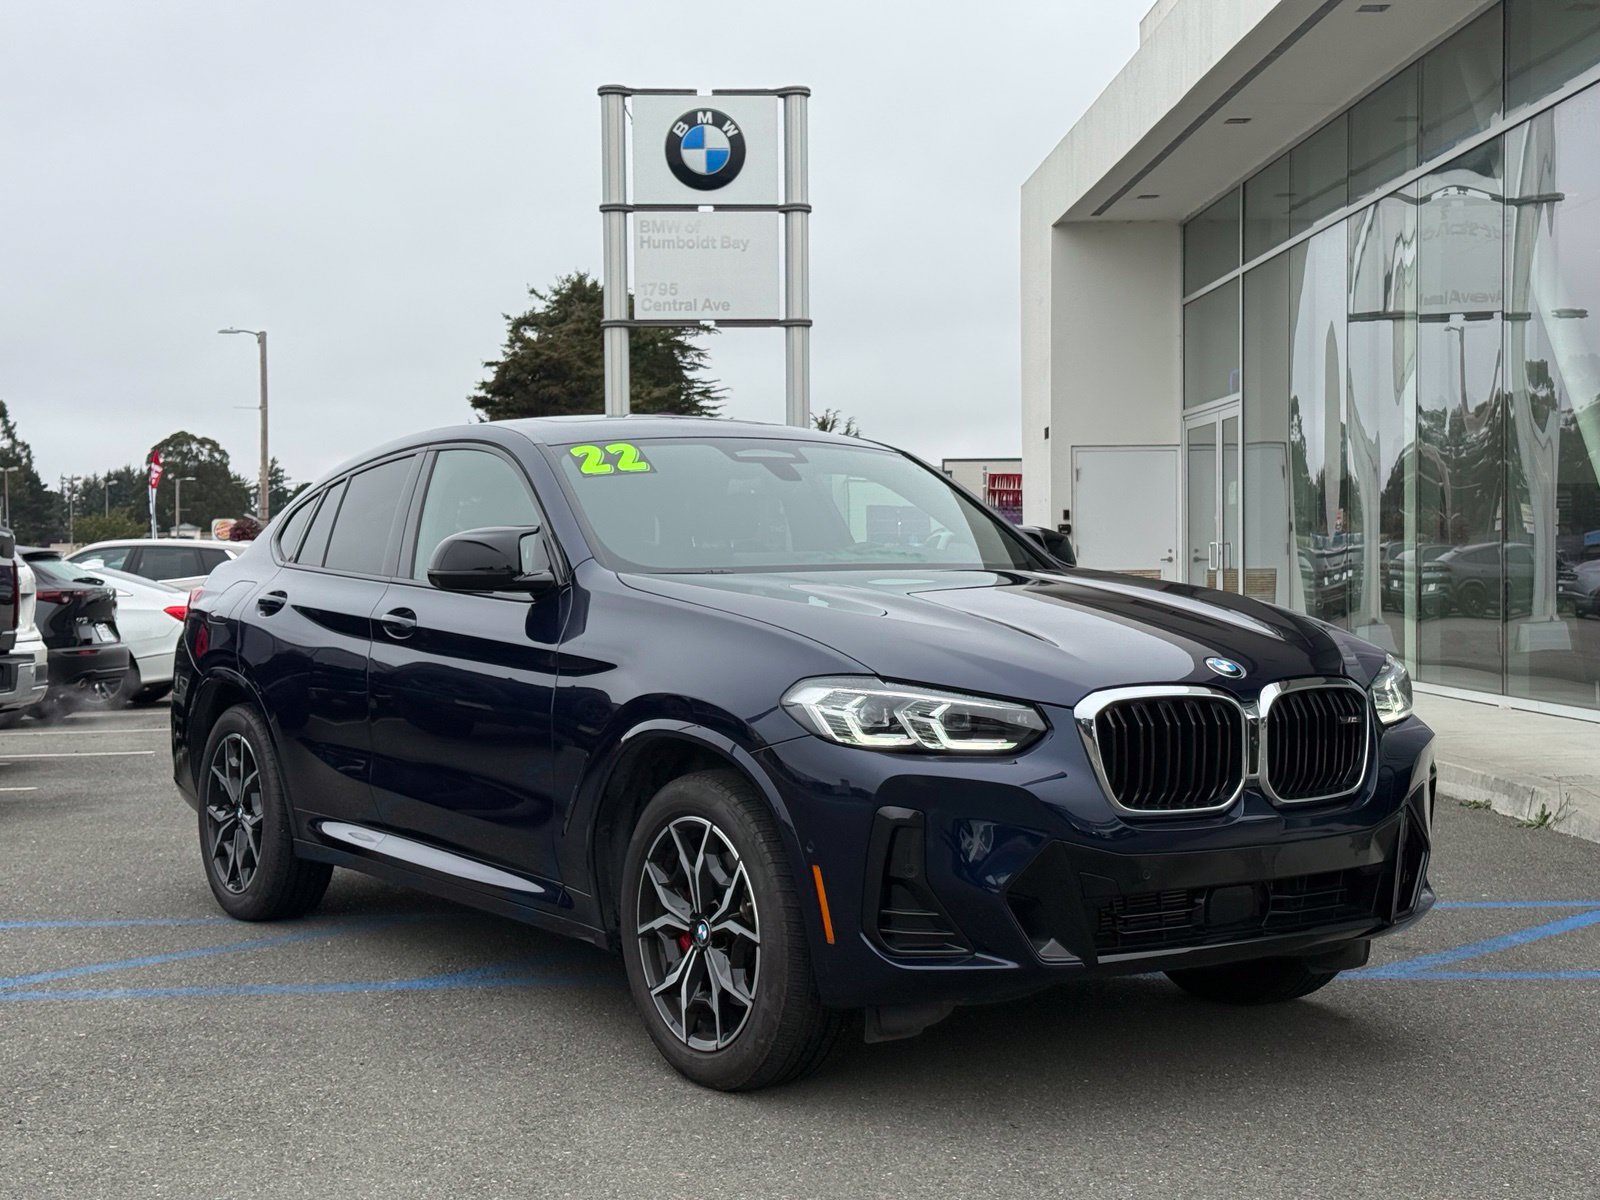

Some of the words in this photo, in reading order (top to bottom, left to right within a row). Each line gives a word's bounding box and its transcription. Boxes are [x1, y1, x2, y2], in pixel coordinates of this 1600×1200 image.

[672, 111, 739, 138] BMW
[639, 219, 681, 233] BMW
[684, 219, 702, 233] of
[639, 235, 717, 249] Humboldt
[720, 235, 750, 252] Bay
[640, 282, 679, 296] 1795
[641, 297, 697, 311] Central
[701, 297, 731, 311] Ave
[569, 442, 651, 475] 22
